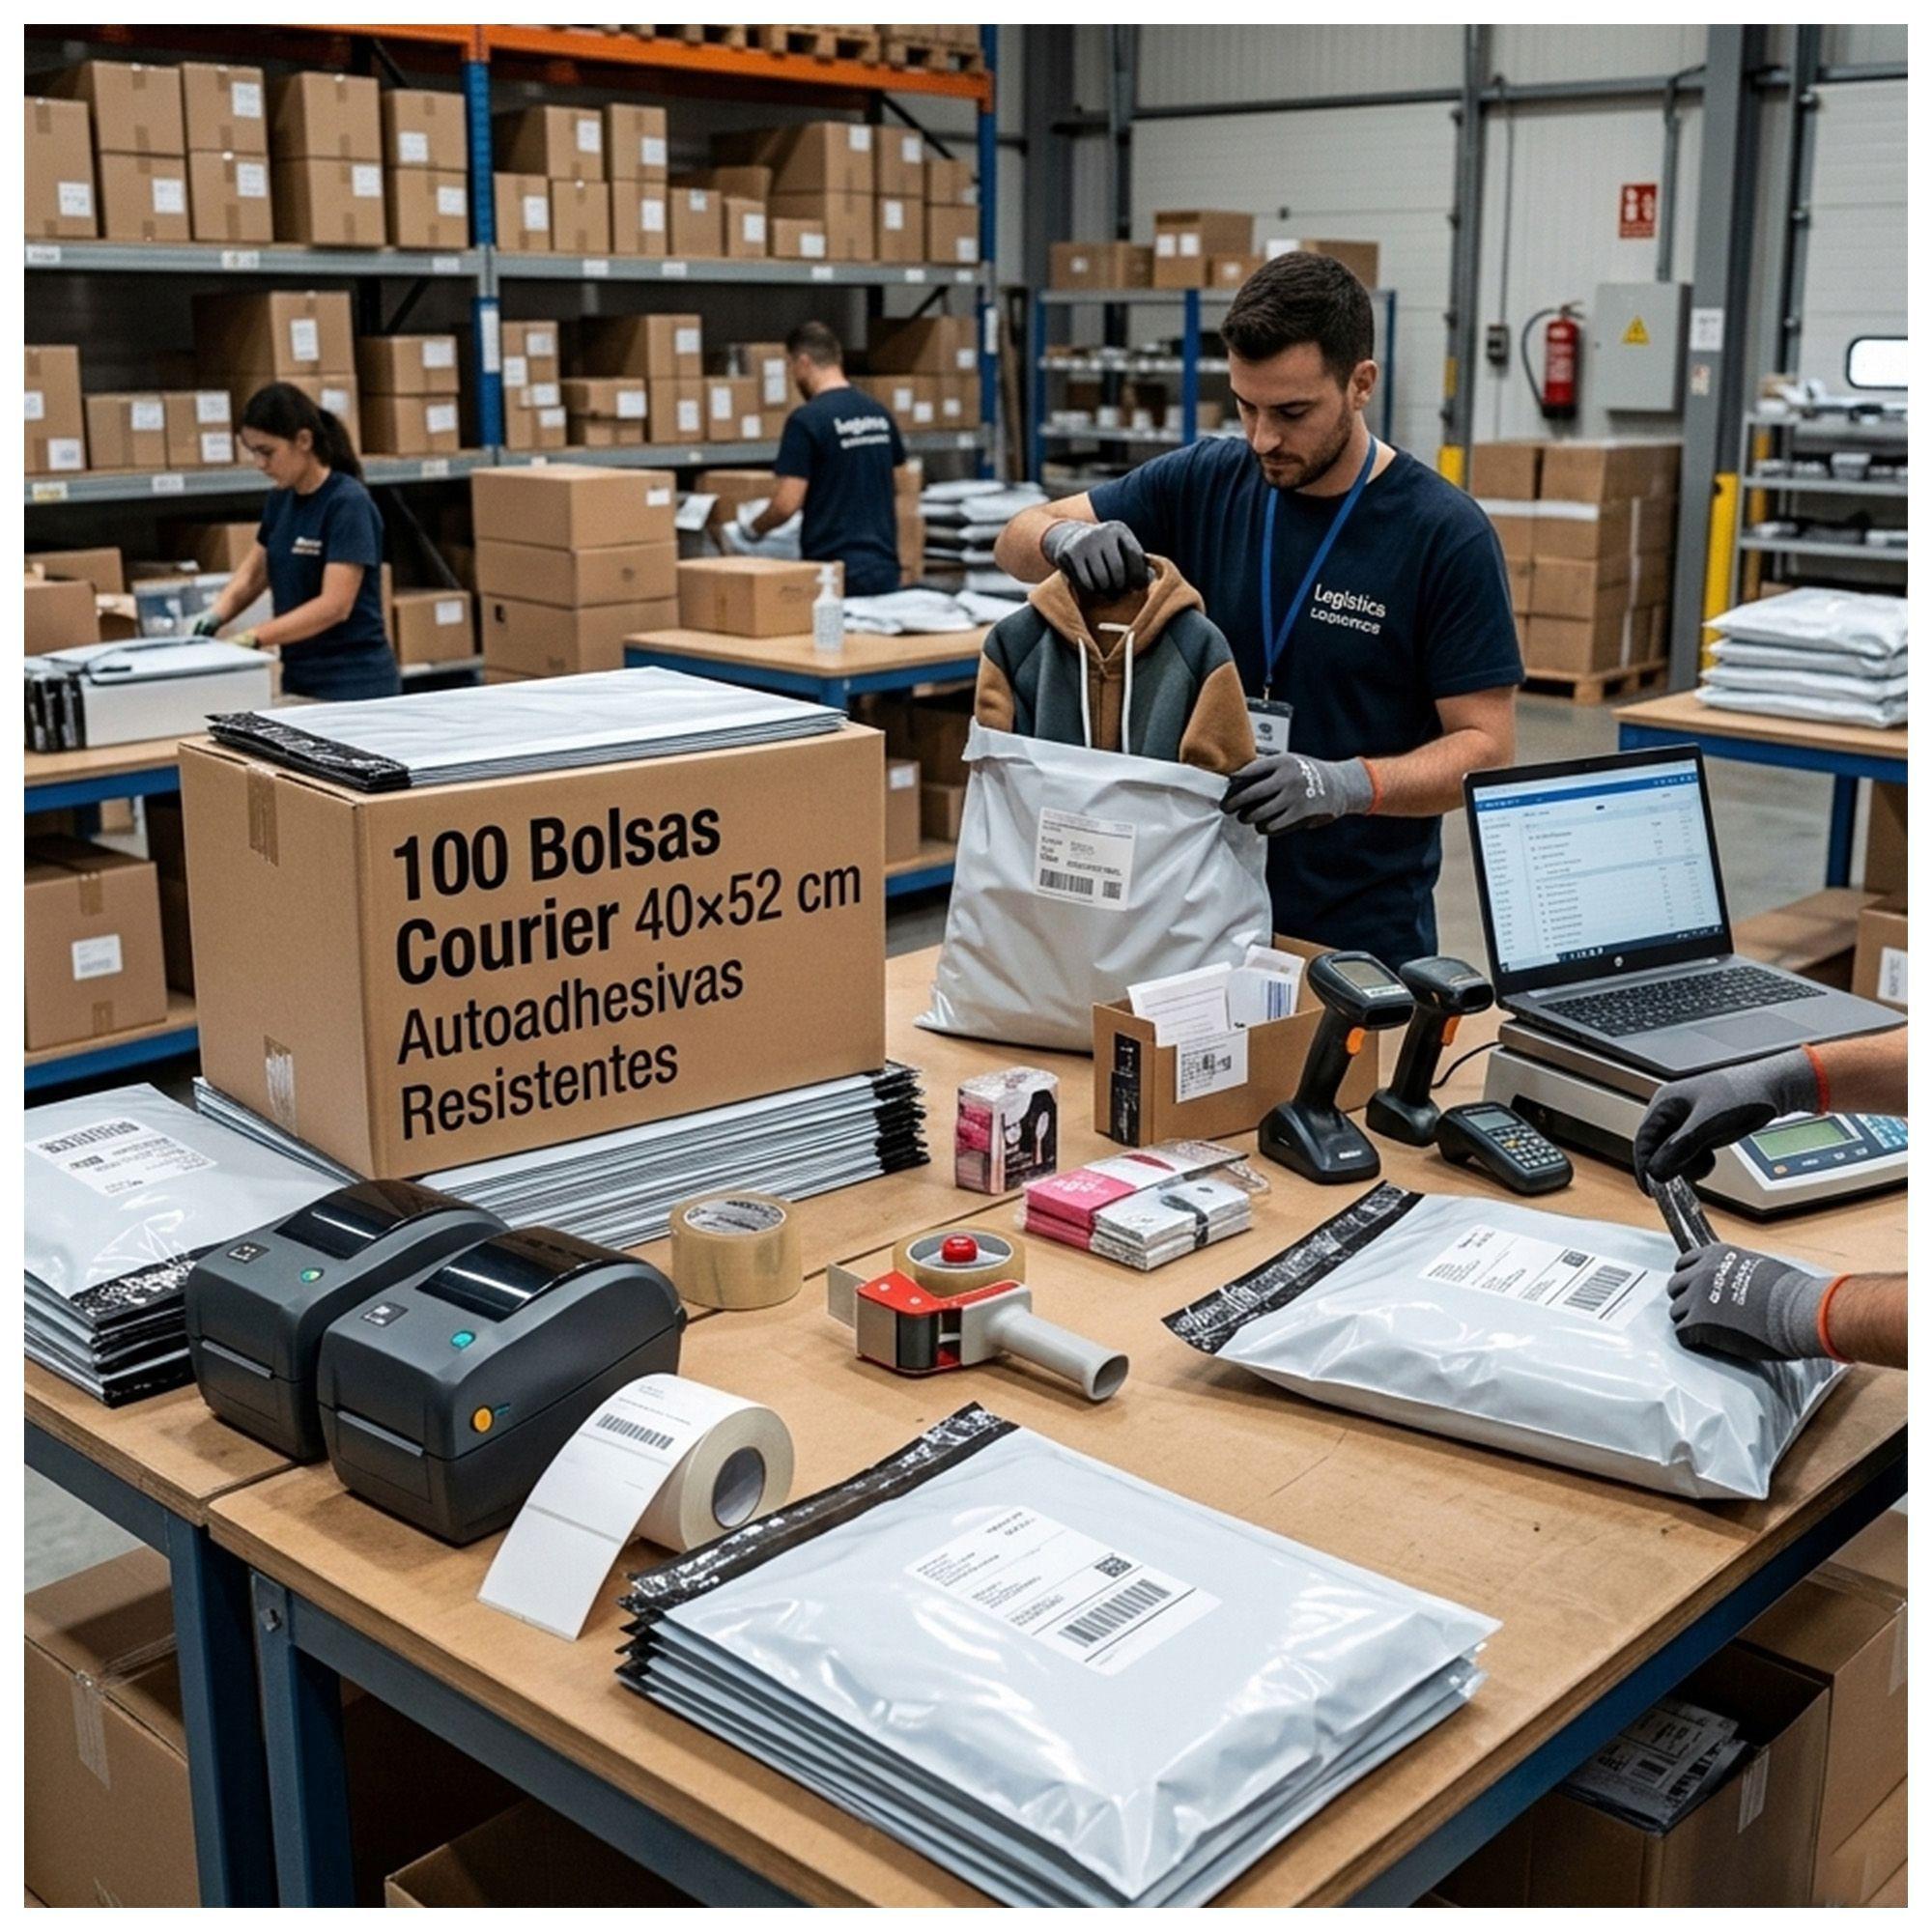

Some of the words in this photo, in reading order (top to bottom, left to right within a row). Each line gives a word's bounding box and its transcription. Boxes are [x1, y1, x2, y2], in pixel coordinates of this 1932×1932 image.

[393, 823, 509, 901] 100
[528, 807, 722, 883] Bolsas
[395, 896, 620, 986] Courier
[797, 864, 862, 914] cm
[396, 958, 744, 1066] Autoadhesivas
[401, 1042, 679, 1142] Resistentes
